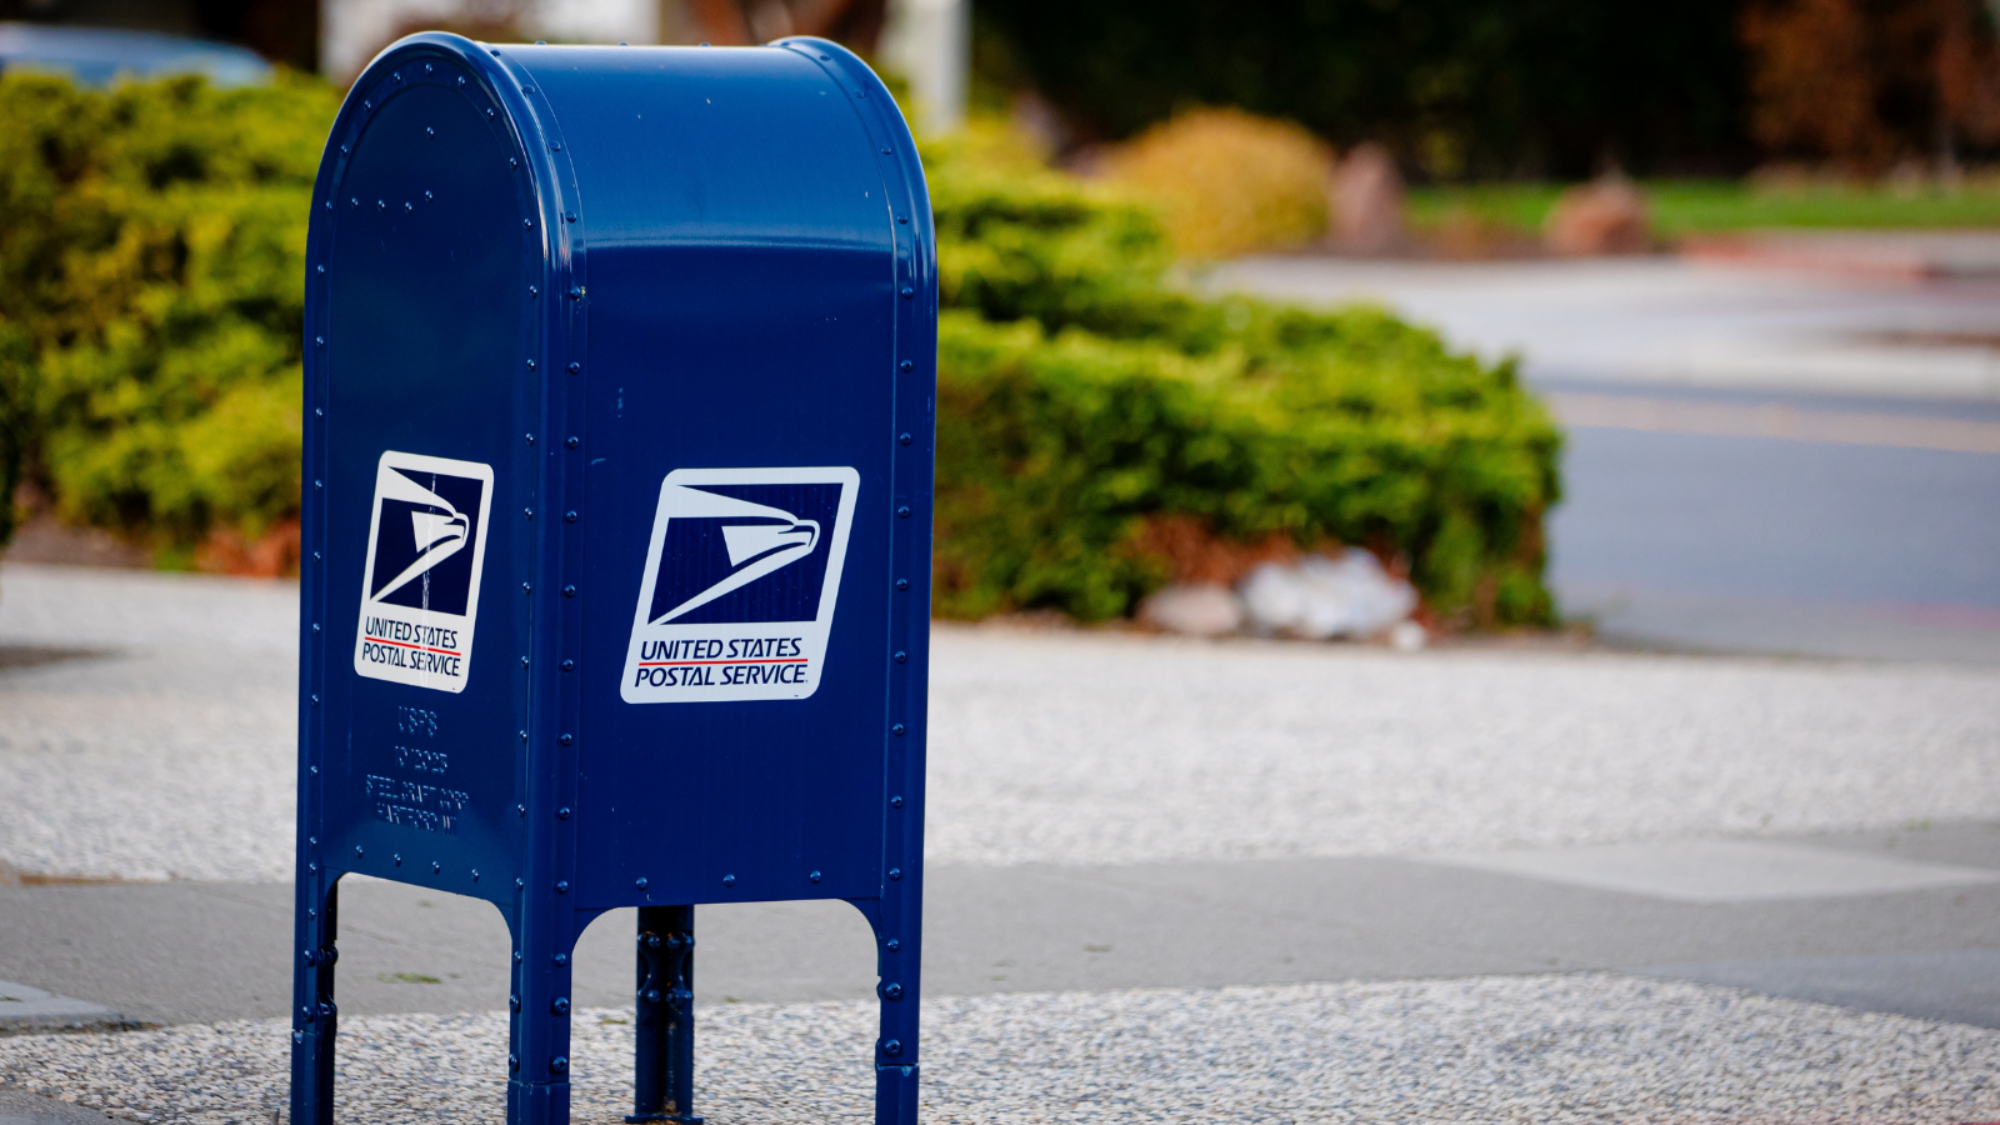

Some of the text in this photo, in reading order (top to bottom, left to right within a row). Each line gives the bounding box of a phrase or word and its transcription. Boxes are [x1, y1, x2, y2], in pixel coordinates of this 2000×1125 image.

[365, 616, 458, 649] UNITED STATES
[362, 642, 461, 677] POSTAL SERVICE
[640, 637, 803, 660] UNITED STATES
[634, 664, 808, 687] POSTAL SERVICE
